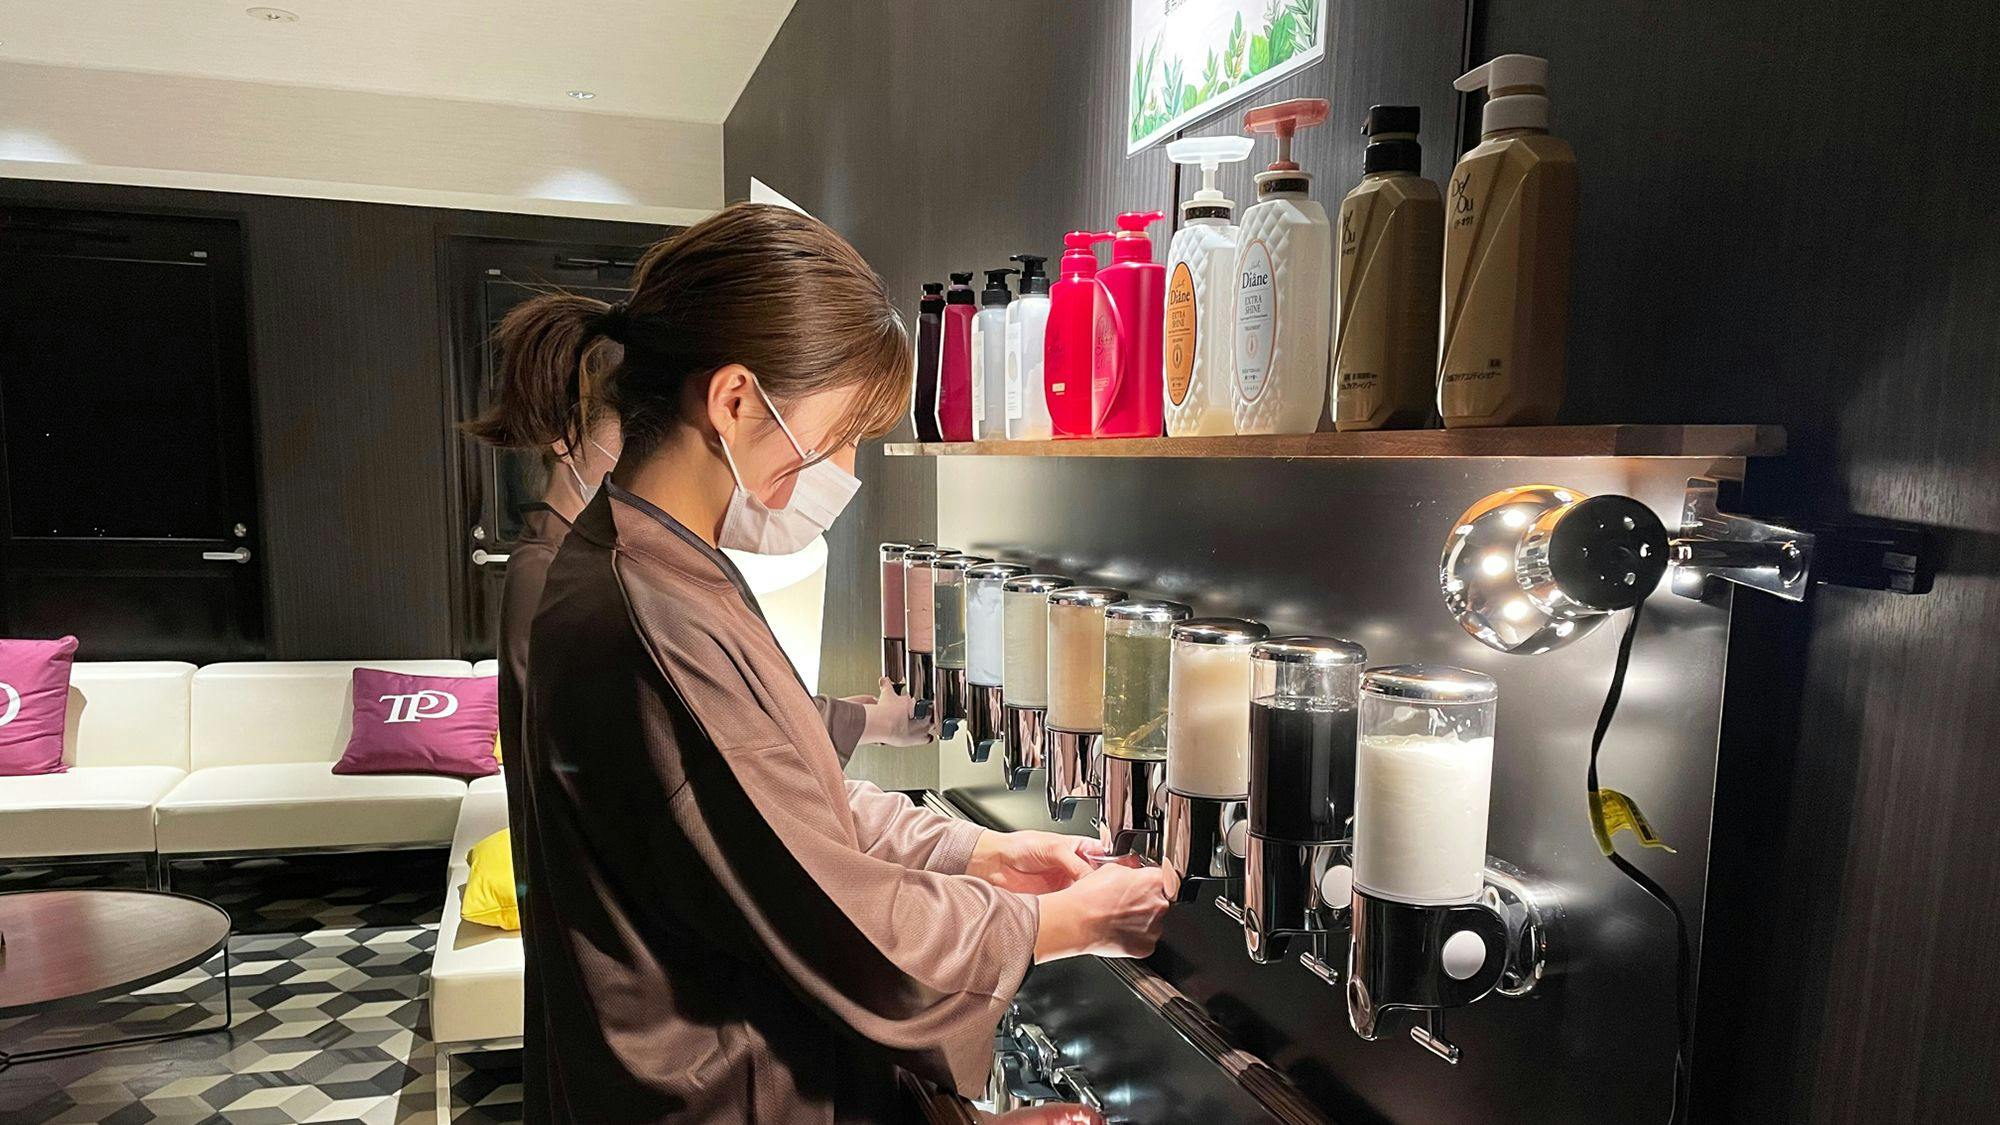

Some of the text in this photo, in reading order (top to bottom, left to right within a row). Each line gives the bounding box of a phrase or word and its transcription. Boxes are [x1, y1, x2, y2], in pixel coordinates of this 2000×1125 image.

[1242, 272, 1269, 289] Diâne
[1245, 295, 1263, 306] EXTRA
[1245, 304, 1262, 315] SHINE
